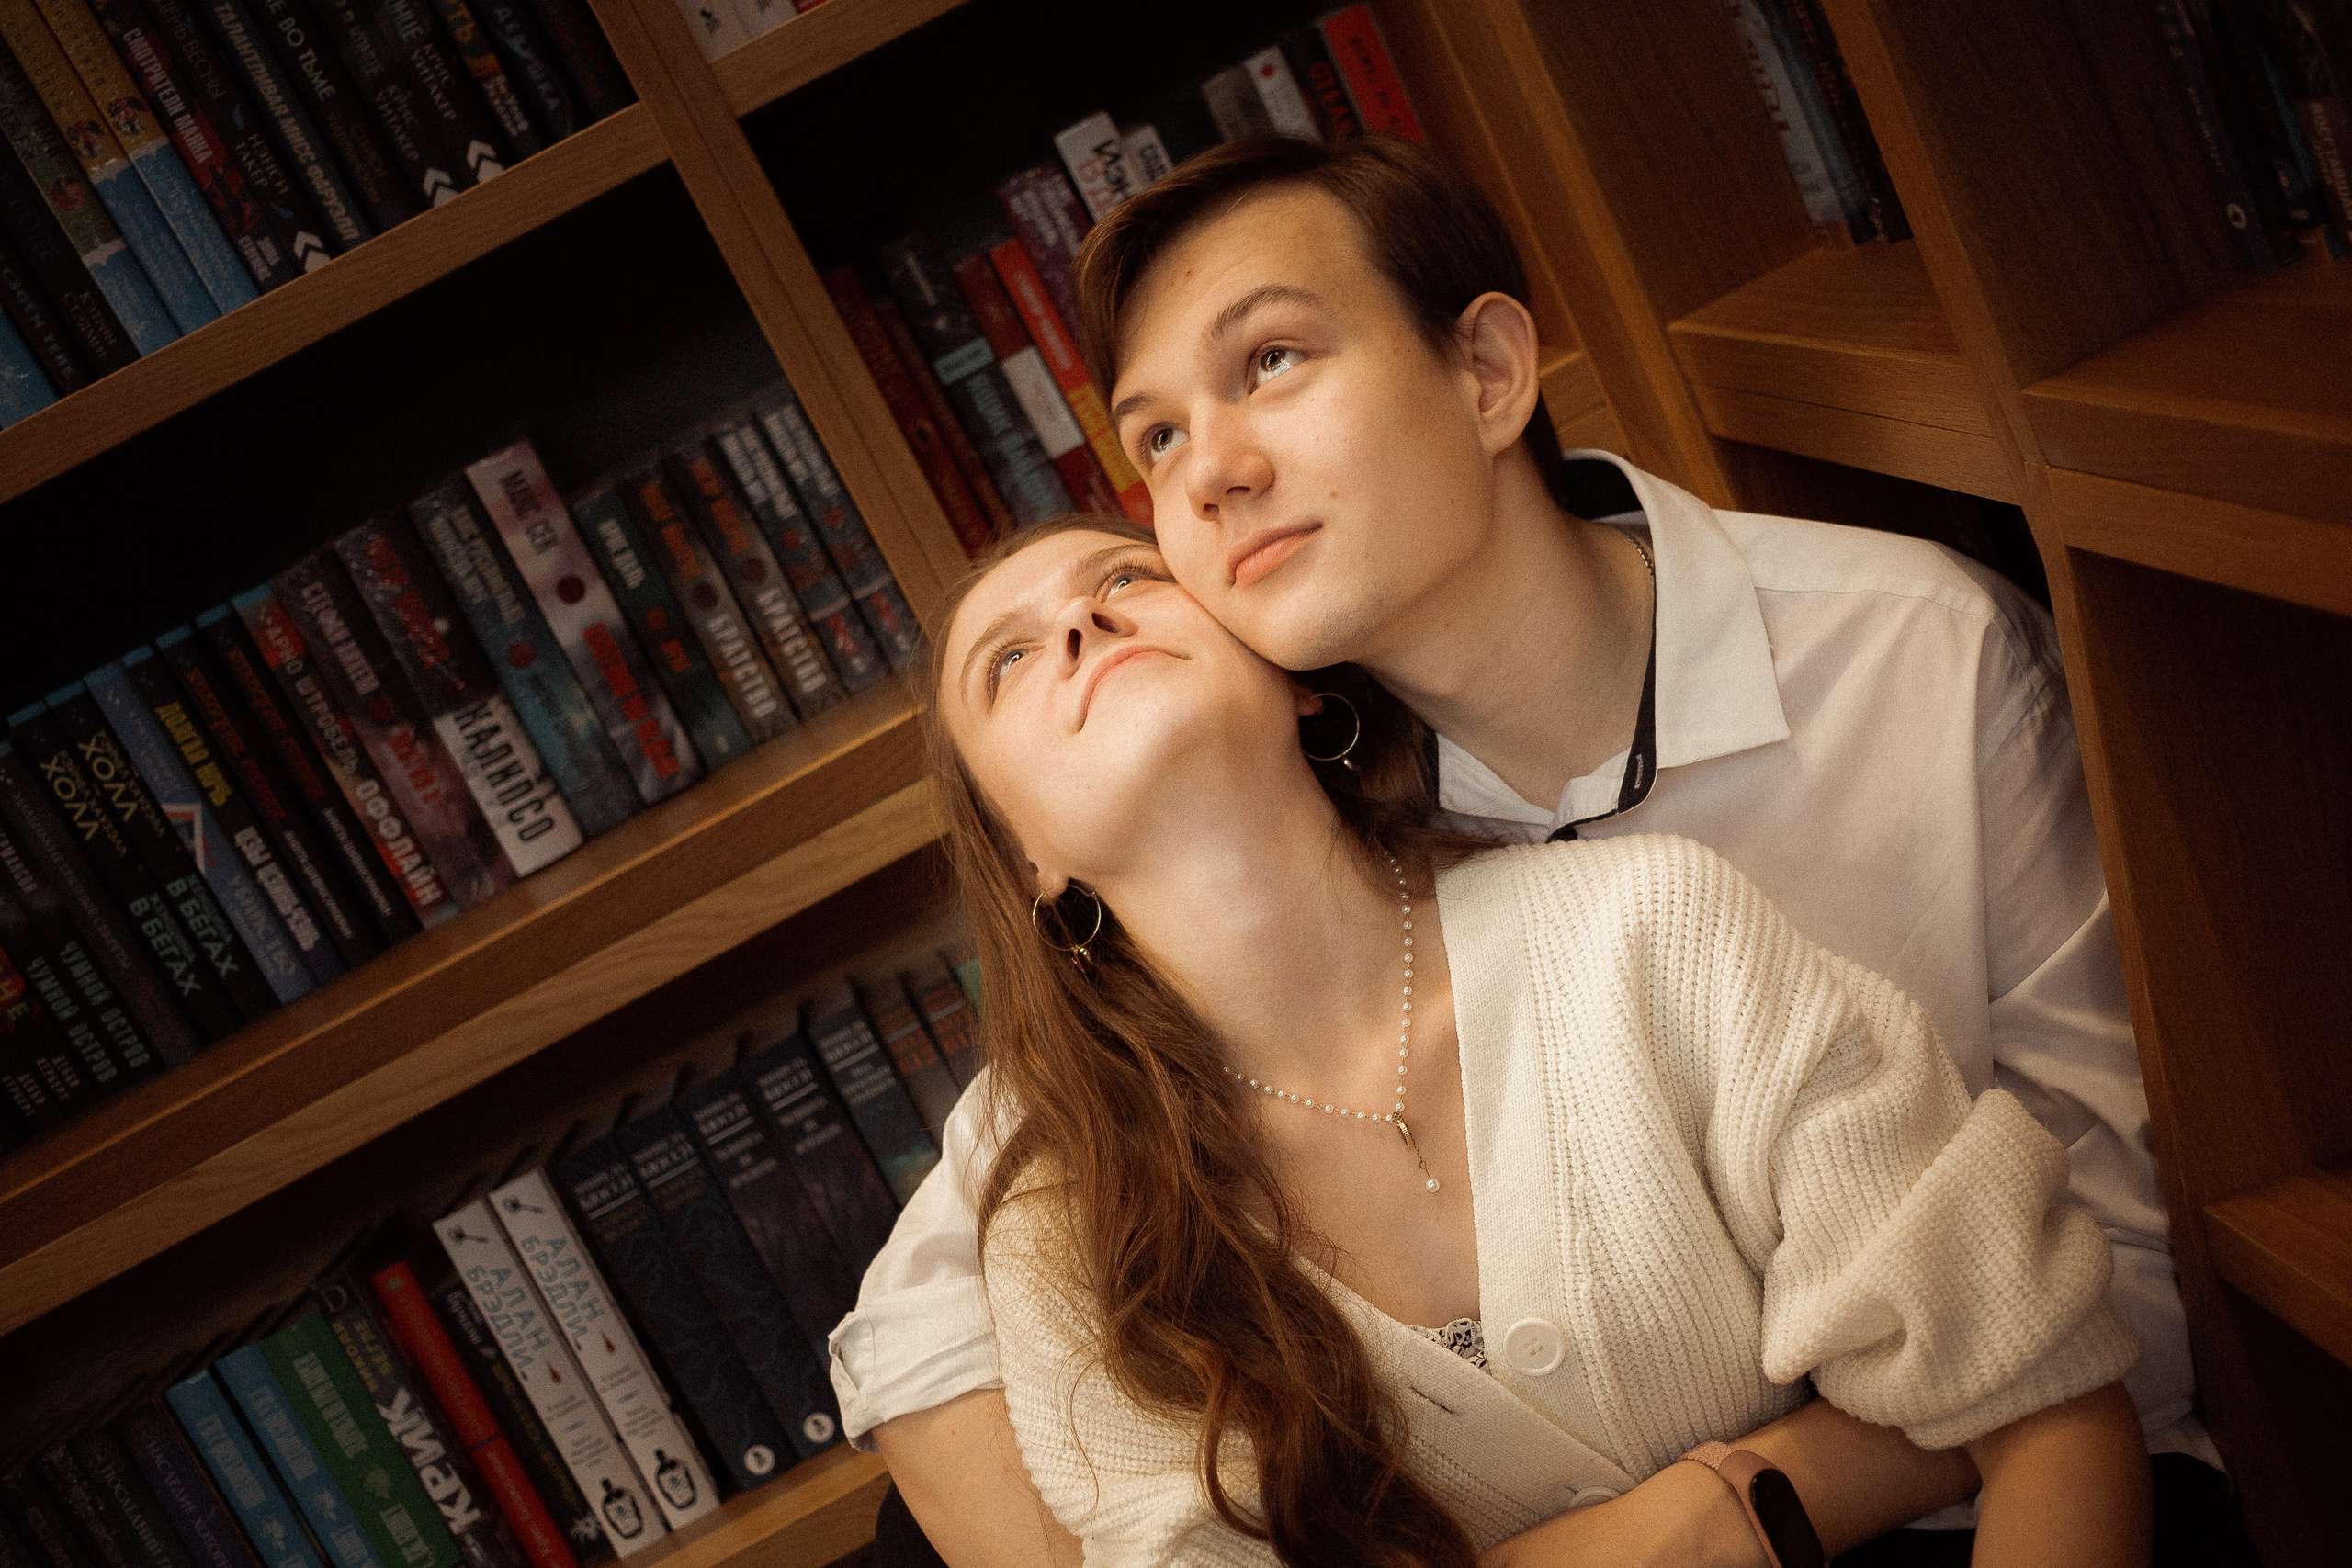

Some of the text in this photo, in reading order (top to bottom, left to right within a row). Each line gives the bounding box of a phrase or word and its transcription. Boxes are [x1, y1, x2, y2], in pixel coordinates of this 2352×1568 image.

[121, 27, 186, 117] СМОТРИТЕЛИ
[173, 113, 213, 164] МАЯКА
[181, 39, 227, 101] ВЕСНЫ
[277, 15, 307, 50] ВО
[295, 48, 336, 101] ТЬМЕ
[406, 50, 458, 123] УИТАКЕР
[420, 41, 456, 89] КРИС
[210, 1, 361, 245] ТАЛАНТЛИВАЯ МИСС ФАРУЭЛЛ
[369, 91, 421, 164] УИТАКЕР
[384, 83, 419, 128] КРИС
[233, 141, 269, 190] ТАКЕР
[245, 132, 290, 195] НЭНСИ
[967, 373, 1013, 435] ЯЩИК
[56, 748, 93, 799] РЭЙЧЕЛ
[76, 733, 141, 823] ХОЛЛ
[96, 728, 131, 780] РЭЙЧЕЛ
[153, 697, 210, 769] ДОЛГАЯ
[193, 760, 235, 808] НОЧЬ
[261, 623, 448, 908] АРНО ШТРОБЕЛЬ ОФФЛАЙН
[449, 700, 560, 846] КАЛИПСО
[37, 752, 103, 843] ХОЛЛ
[91, 913, 133, 971] СЕКРЕТЫ
[126, 896, 152, 919] В
[139, 915, 201, 999] БЕГАХ
[146, 891, 198, 966] ЖЕНЩИНА
[164, 876, 239, 980] В БЕГАХ
[184, 872, 234, 946] ЖЕНЩИНА
[24, 953, 119, 1086] ЧУМНОЙ ОСТРОВ
[55, 937, 151, 1071] ЧУМНОЙ ОСТРОВ
[17, 1071, 46, 1108] ДЕББИ
[35, 1055, 69, 1102] ХЕРБЕРТ
[51, 1053, 80, 1090] ДЕББИ
[461, 1264, 537, 1371] БРЭДЛИ
[486, 1261, 554, 1354] АЛАН
[515, 1233, 593, 1341] БРЭДЛИ
[540, 1231, 608, 1323] АЛАН
[330, 1318, 381, 1393] НИКОЛЯ
[142, 1438, 198, 1517] НАСЛЕДИЕ
[372, 1381, 487, 1536] КРИК
[99, 1462, 165, 1558] ПОСЛЕДНИЙ
